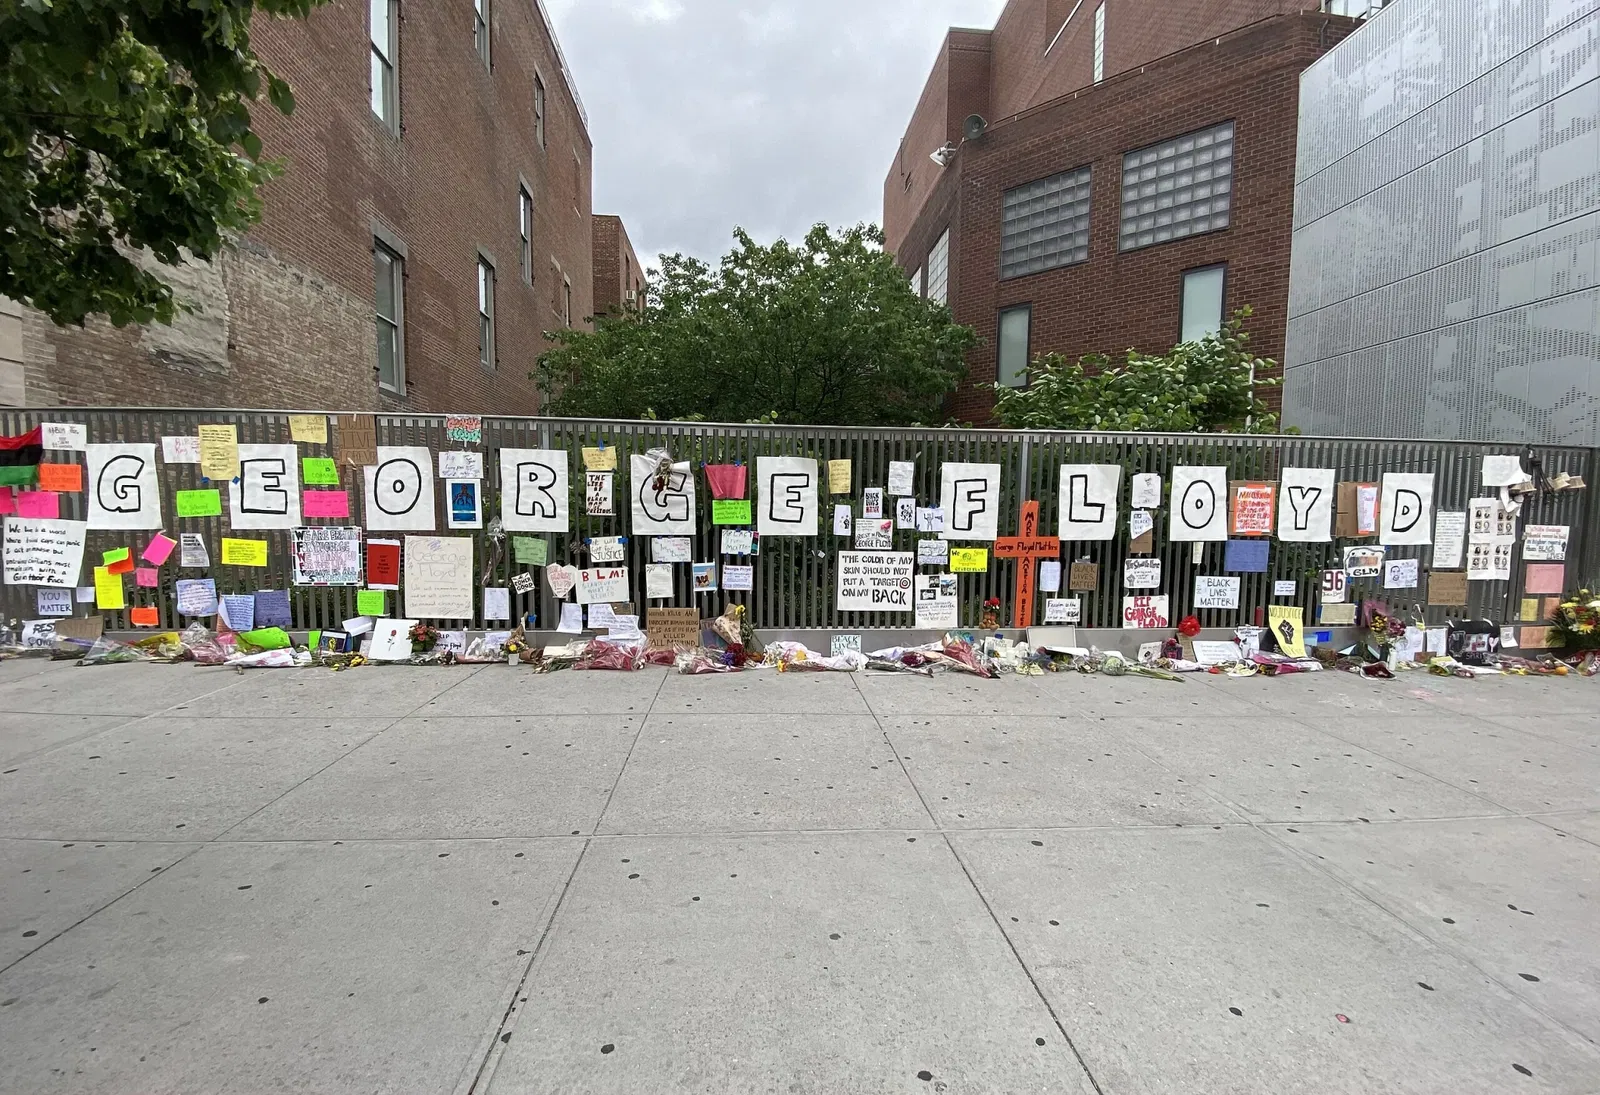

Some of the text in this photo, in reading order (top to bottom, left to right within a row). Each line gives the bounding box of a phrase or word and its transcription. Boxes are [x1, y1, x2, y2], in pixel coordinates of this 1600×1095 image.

[1017, 542, 1034, 554] Floyd
[592, 550, 623, 560] JUSTICE
[842, 555, 859, 563] THE
[862, 556, 884, 564] COLOR
[899, 557, 913, 565] MY
[893, 567, 909, 575] NOT
[1073, 564, 1095, 573] BLACK
[870, 578, 900, 586] TARGET
[1207, 578, 1230, 587] BLACK
[1322, 571, 1344, 591] 96
[41, 592, 60, 600] YOU
[842, 589, 906, 605] ON MY BACK
[1210, 588, 1226, 596] LIVES
[1134, 596, 1151, 607] RIP
[40, 604, 72, 612] MATTER
[1125, 607, 1157, 621] GEORGE
[1138, 615, 1167, 628] FLOYD
